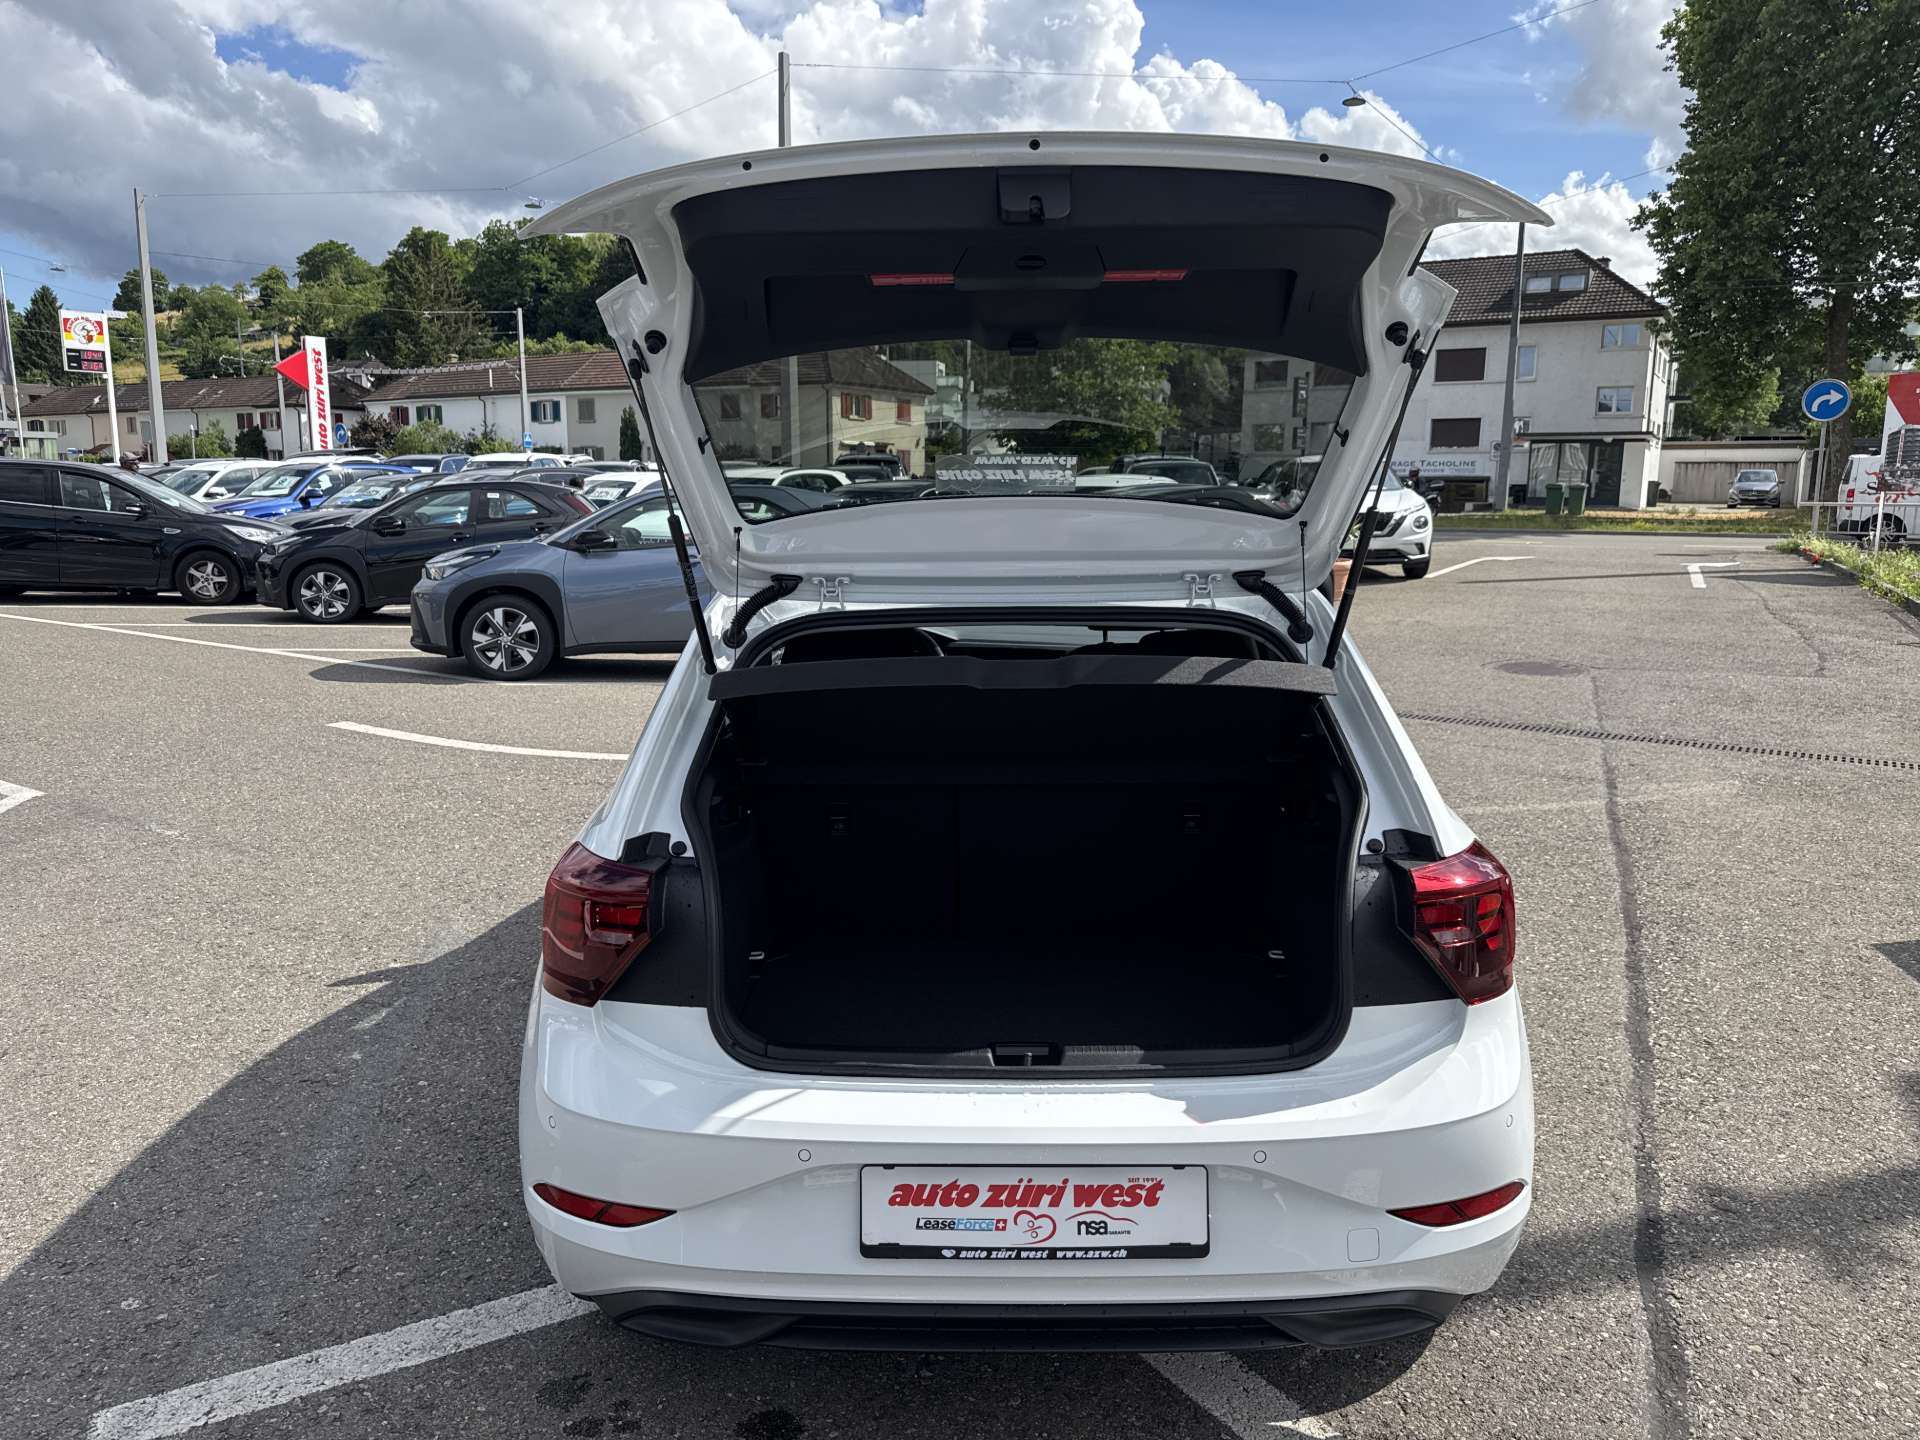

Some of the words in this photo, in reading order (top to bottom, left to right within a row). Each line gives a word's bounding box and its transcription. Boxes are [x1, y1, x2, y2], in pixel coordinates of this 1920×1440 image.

[313, 348, 324, 385] west
[315, 386, 327, 421] züri
[318, 422, 328, 450] uto
[888, 1178, 980, 1208] auto
[980, 1178, 1070, 1208] züri
[1073, 1178, 1165, 1208] west
[915, 1217, 994, 1231] LeaseForce
[1077, 1220, 1108, 1235] nsa
[959, 1249, 987, 1258] auto
[990, 1248, 1017, 1258] züri
[1020, 1249, 1049, 1258] west
[1056, 1249, 1128, 1258] www.azw.ch
